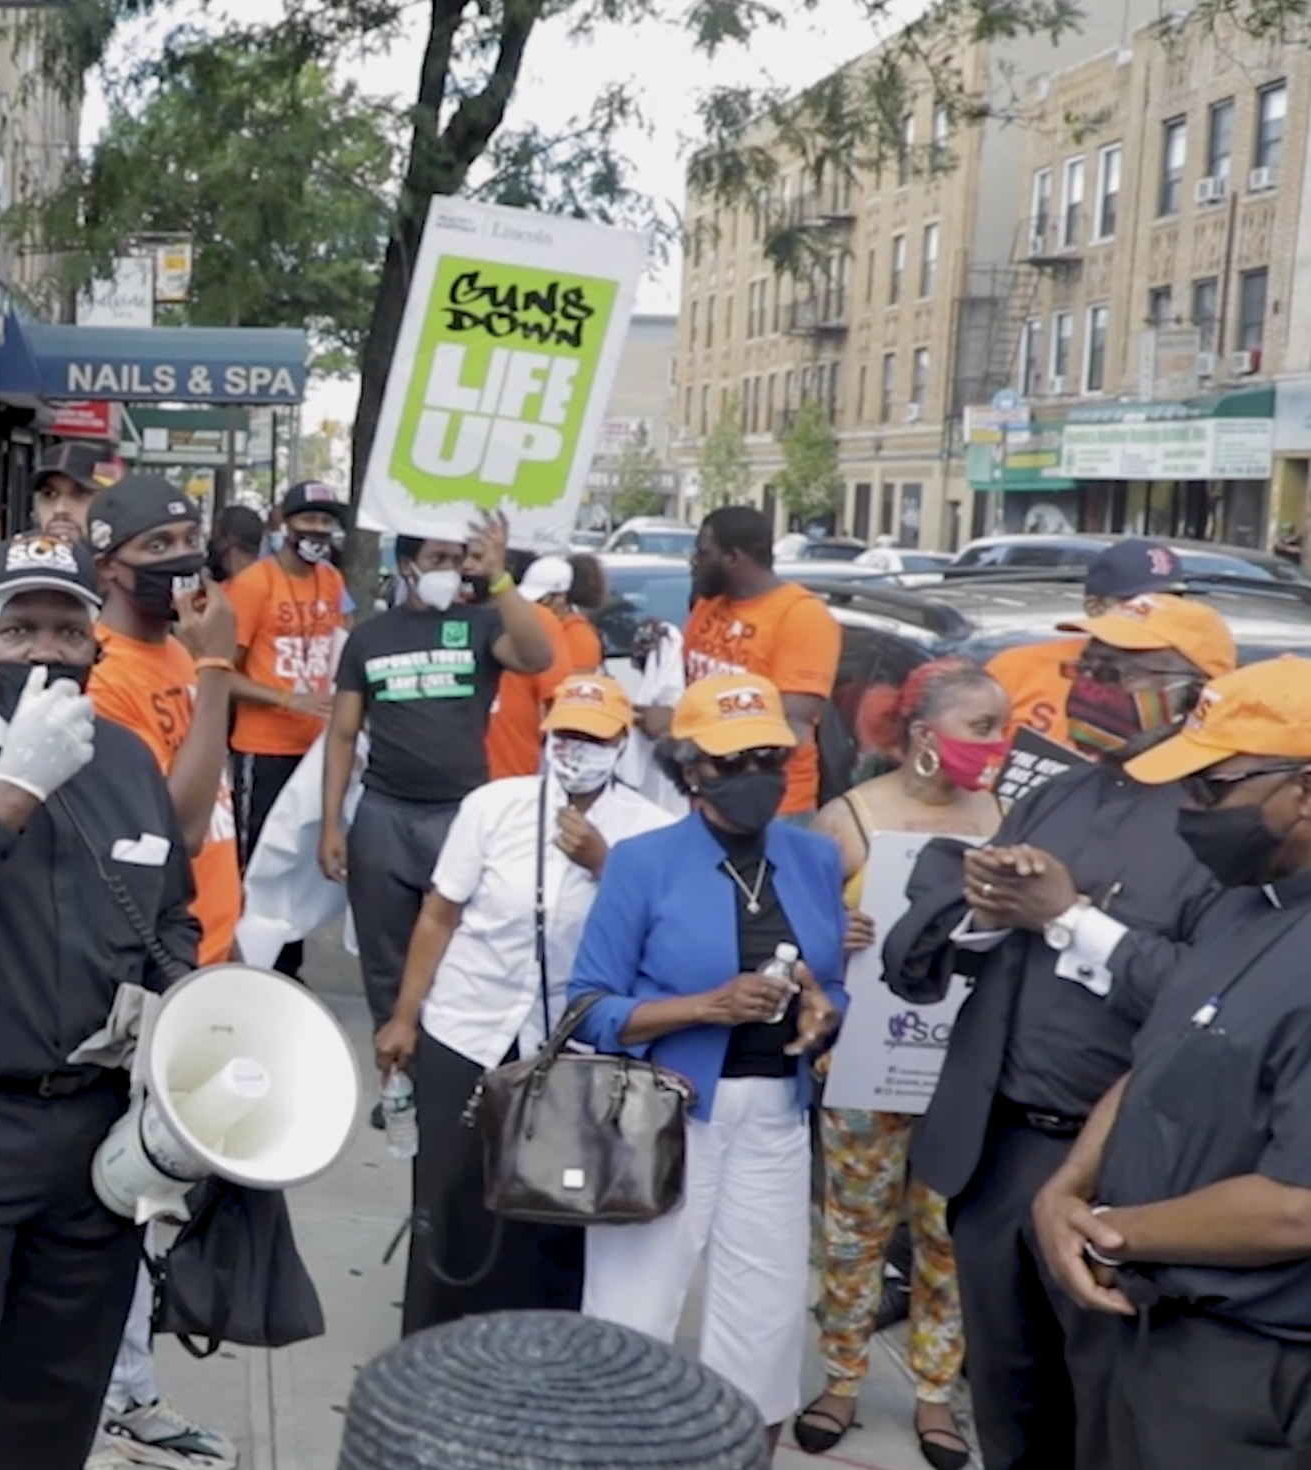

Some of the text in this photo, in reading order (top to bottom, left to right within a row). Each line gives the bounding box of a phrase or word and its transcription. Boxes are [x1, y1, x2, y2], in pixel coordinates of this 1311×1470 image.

[449, 271, 594, 321] GUNS
[442, 307, 583, 349] DOWN
[67, 363, 297, 396] NAILS & SPA
[424, 342, 582, 426] LIFE
[410, 411, 565, 486] UP
[8, 540, 76, 565] SOS
